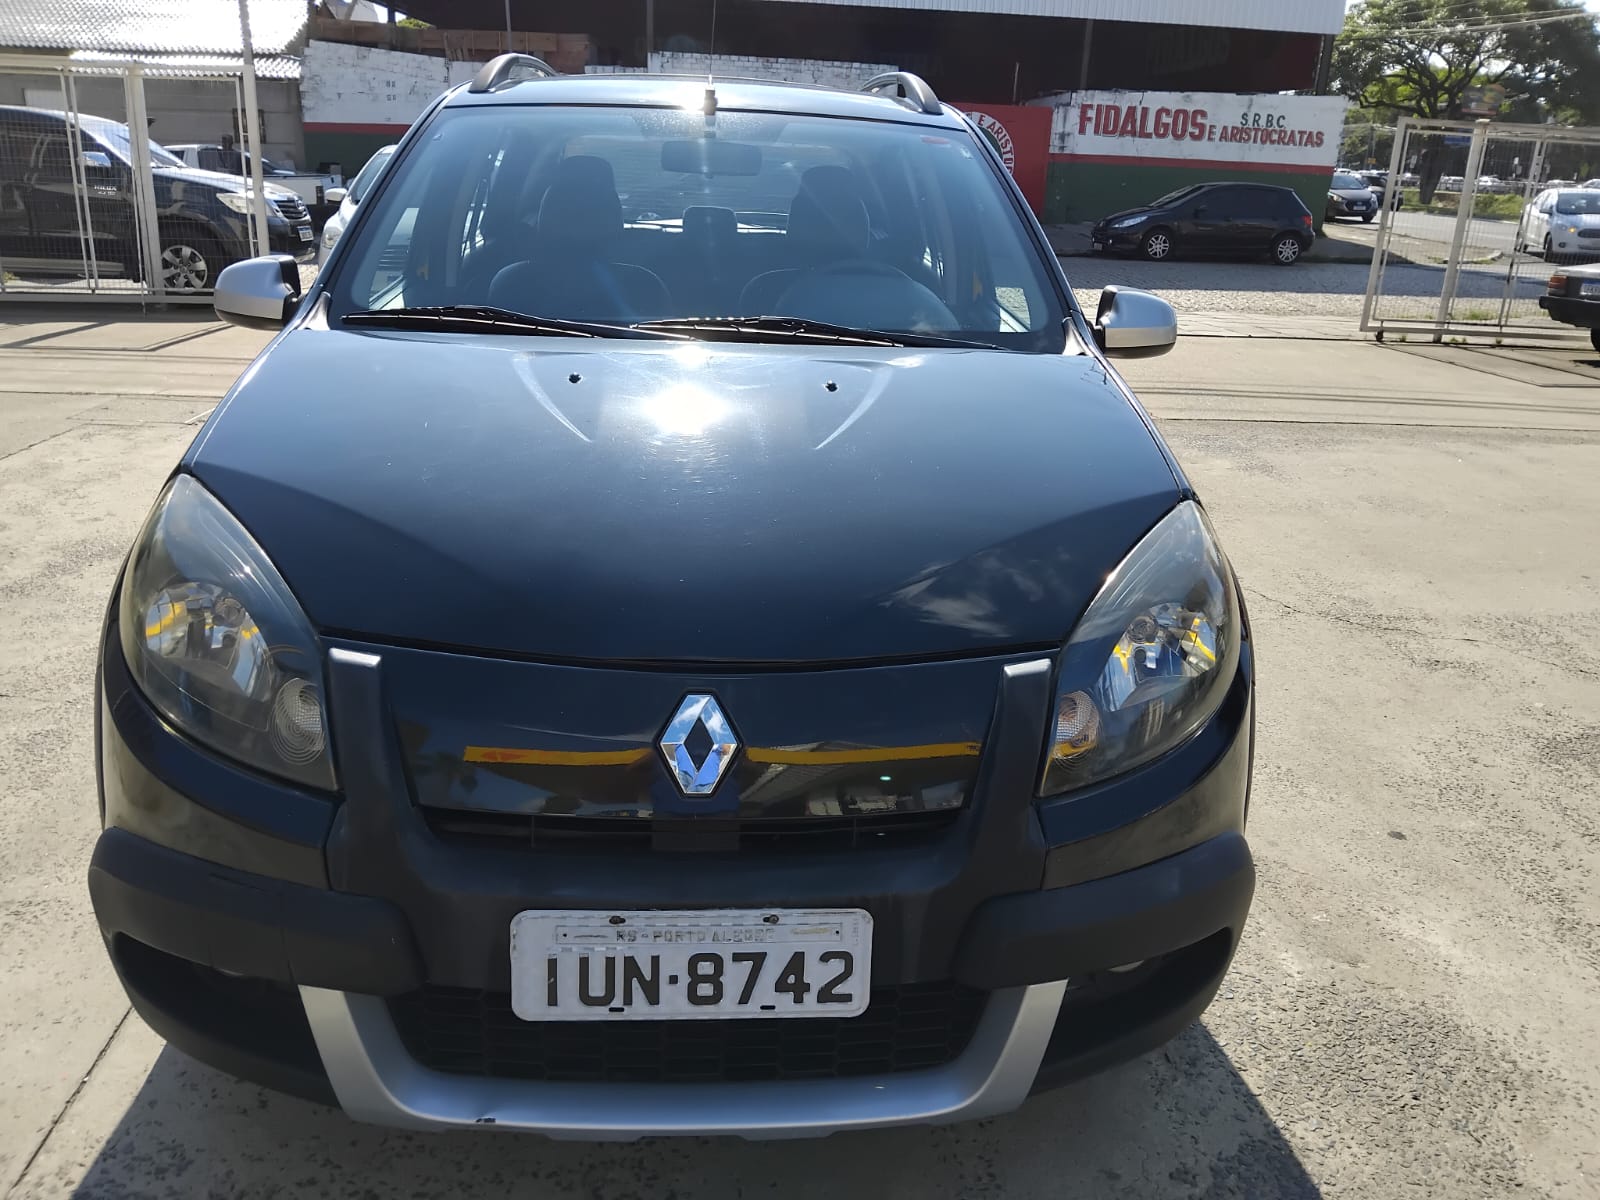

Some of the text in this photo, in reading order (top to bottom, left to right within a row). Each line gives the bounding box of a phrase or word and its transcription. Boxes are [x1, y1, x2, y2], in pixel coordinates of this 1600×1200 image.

[978, 114, 986, 126] E
[1078, 103, 1325, 148] FIDALGOS E ARISTOCRATAS
